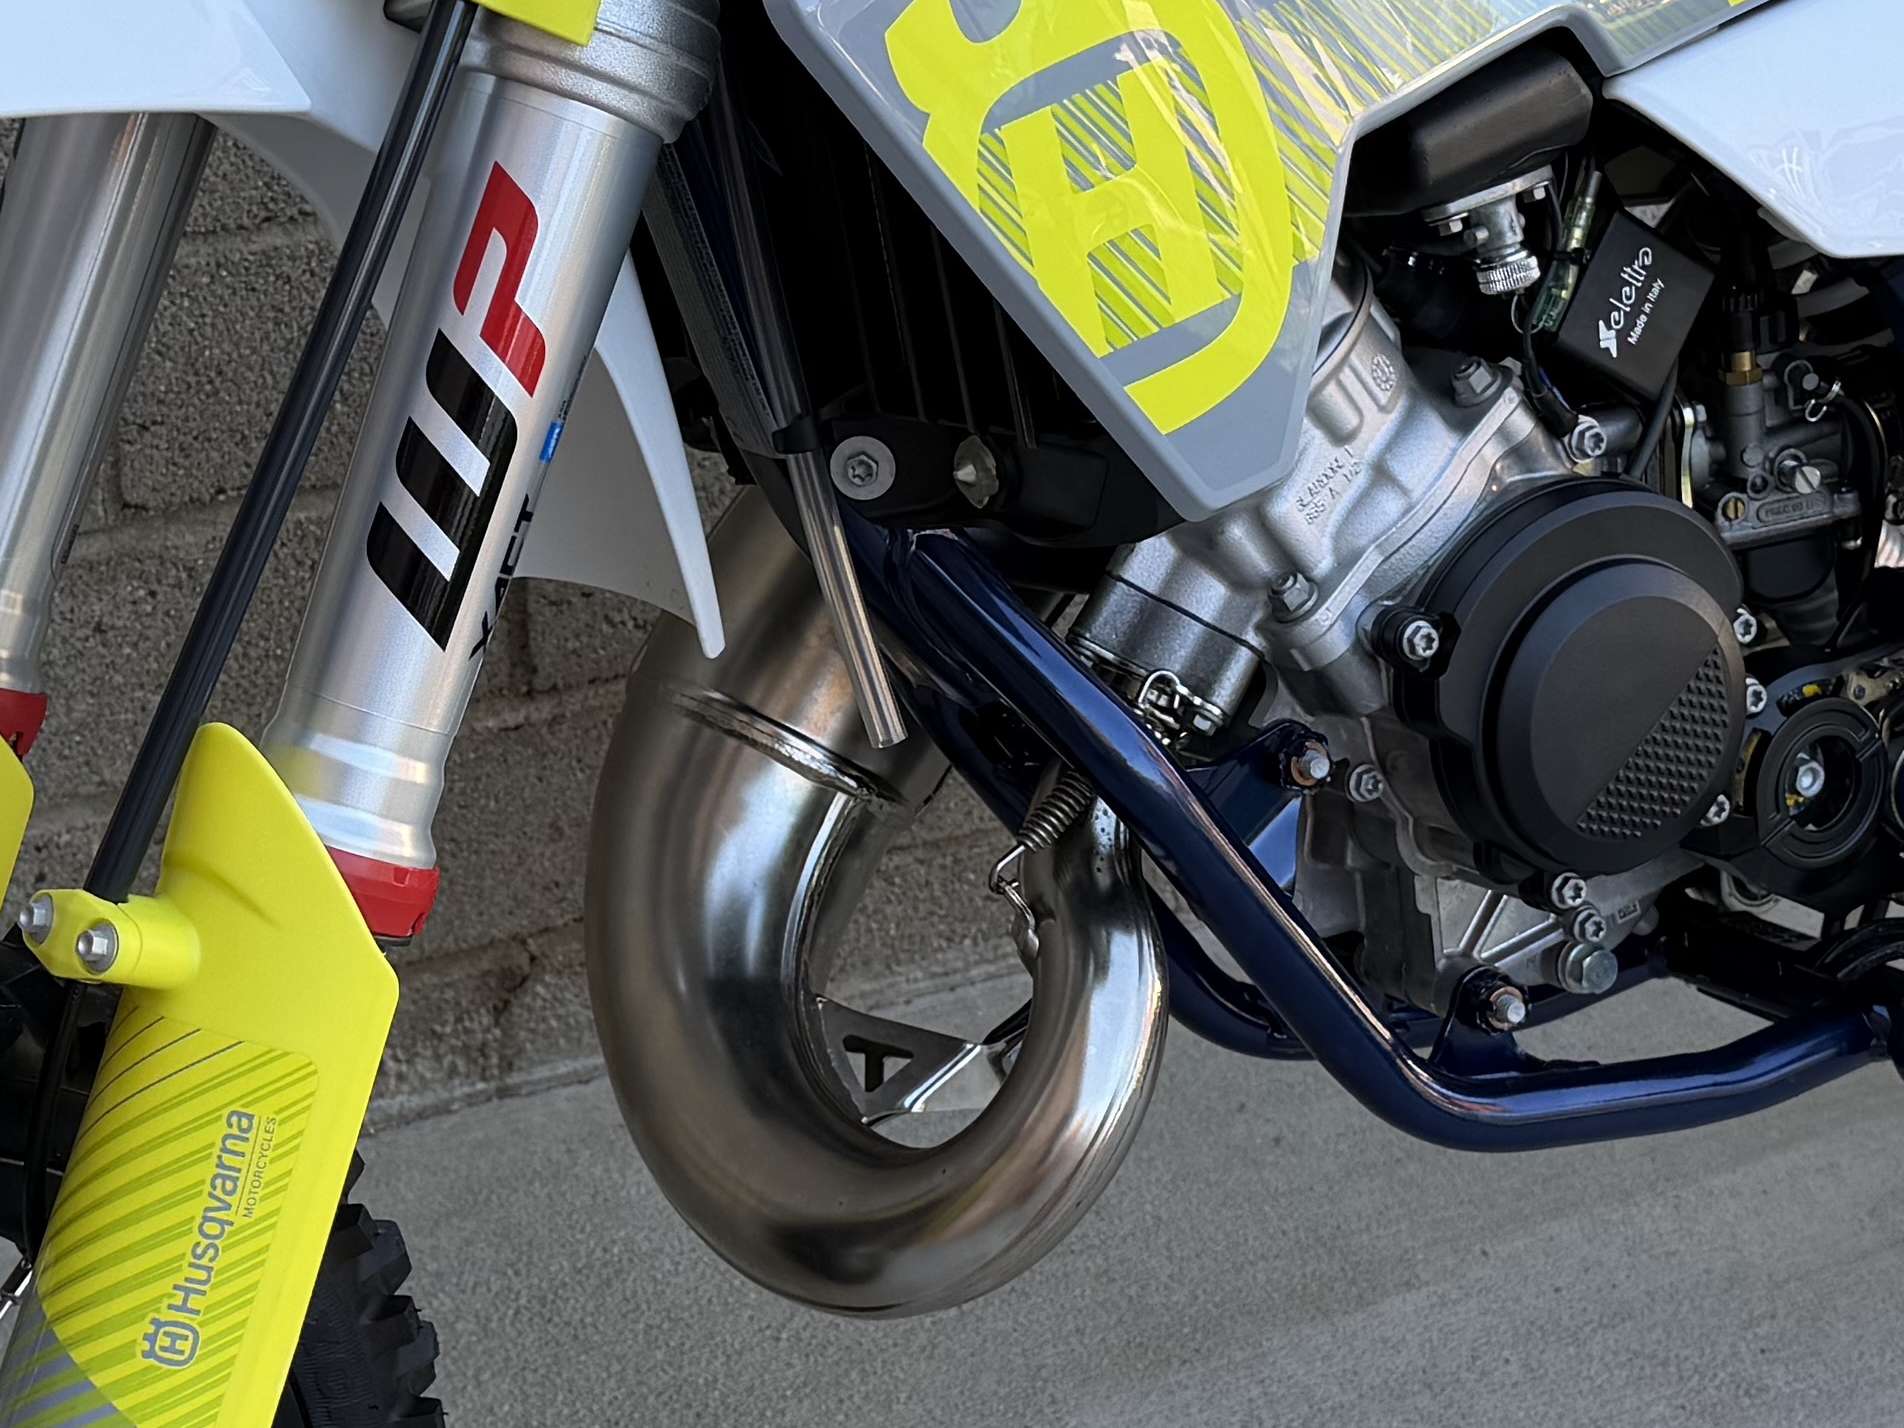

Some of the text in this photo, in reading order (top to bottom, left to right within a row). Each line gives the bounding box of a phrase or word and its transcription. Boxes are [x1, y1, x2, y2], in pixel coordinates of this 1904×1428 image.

[1627, 278, 1665, 345] Made in Italy
[366, 160, 546, 653] WP
[167, 1108, 256, 1318] Husqvarna
[242, 1116, 278, 1219] MOTORCYCLES
